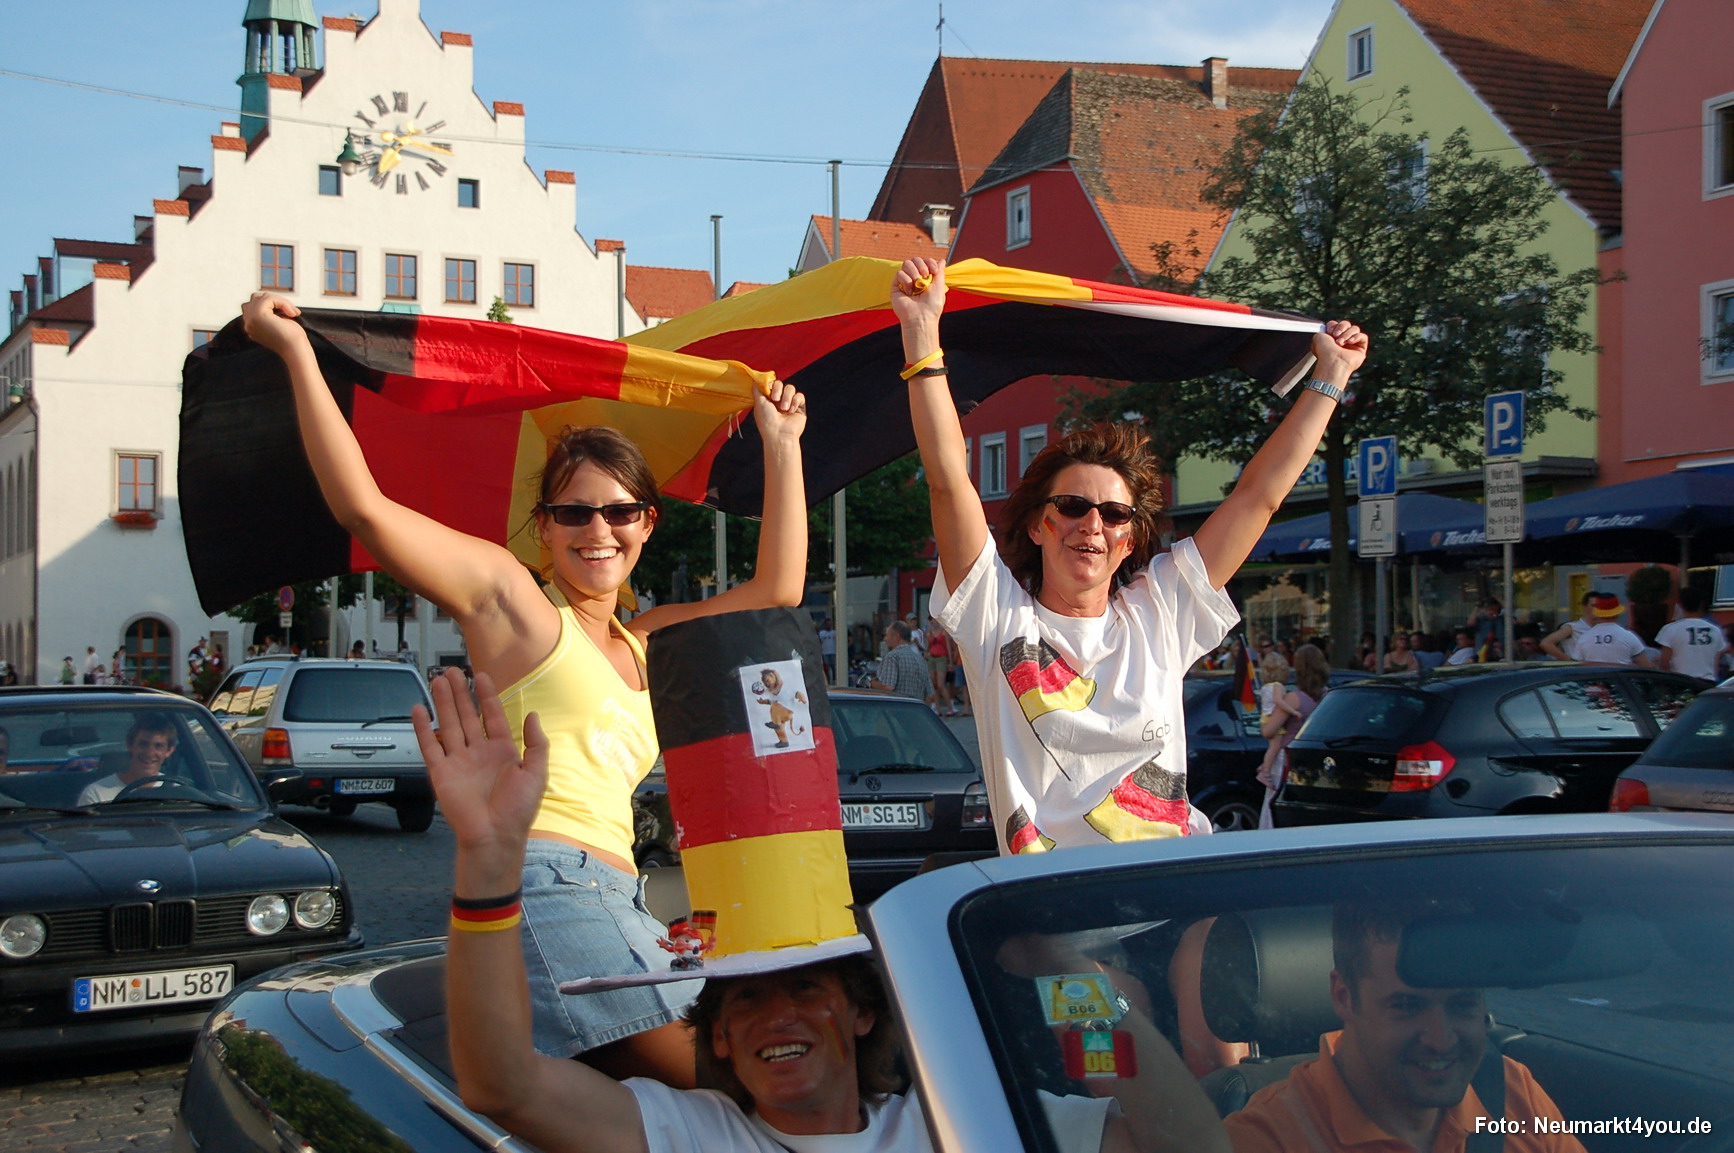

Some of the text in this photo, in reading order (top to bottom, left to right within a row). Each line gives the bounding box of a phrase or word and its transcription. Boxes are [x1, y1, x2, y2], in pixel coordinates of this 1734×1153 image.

[1492, 402, 1514, 449] P
[1367, 445, 1387, 489] P
[1578, 514, 1645, 531] Tucher
[1442, 529, 1487, 546] Tuche
[1594, 634, 1612, 644] 10
[1685, 627, 1712, 645] 13
[341, 780, 393, 791] NM CZ 607
[841, 806, 917, 824] NM SG 15
[93, 979, 127, 1006] NM
[145, 976, 177, 1000] LL
[184, 970, 229, 996] 587
[1068, 1004, 1097, 1015] B06
[1084, 1051, 1116, 1073] 06
